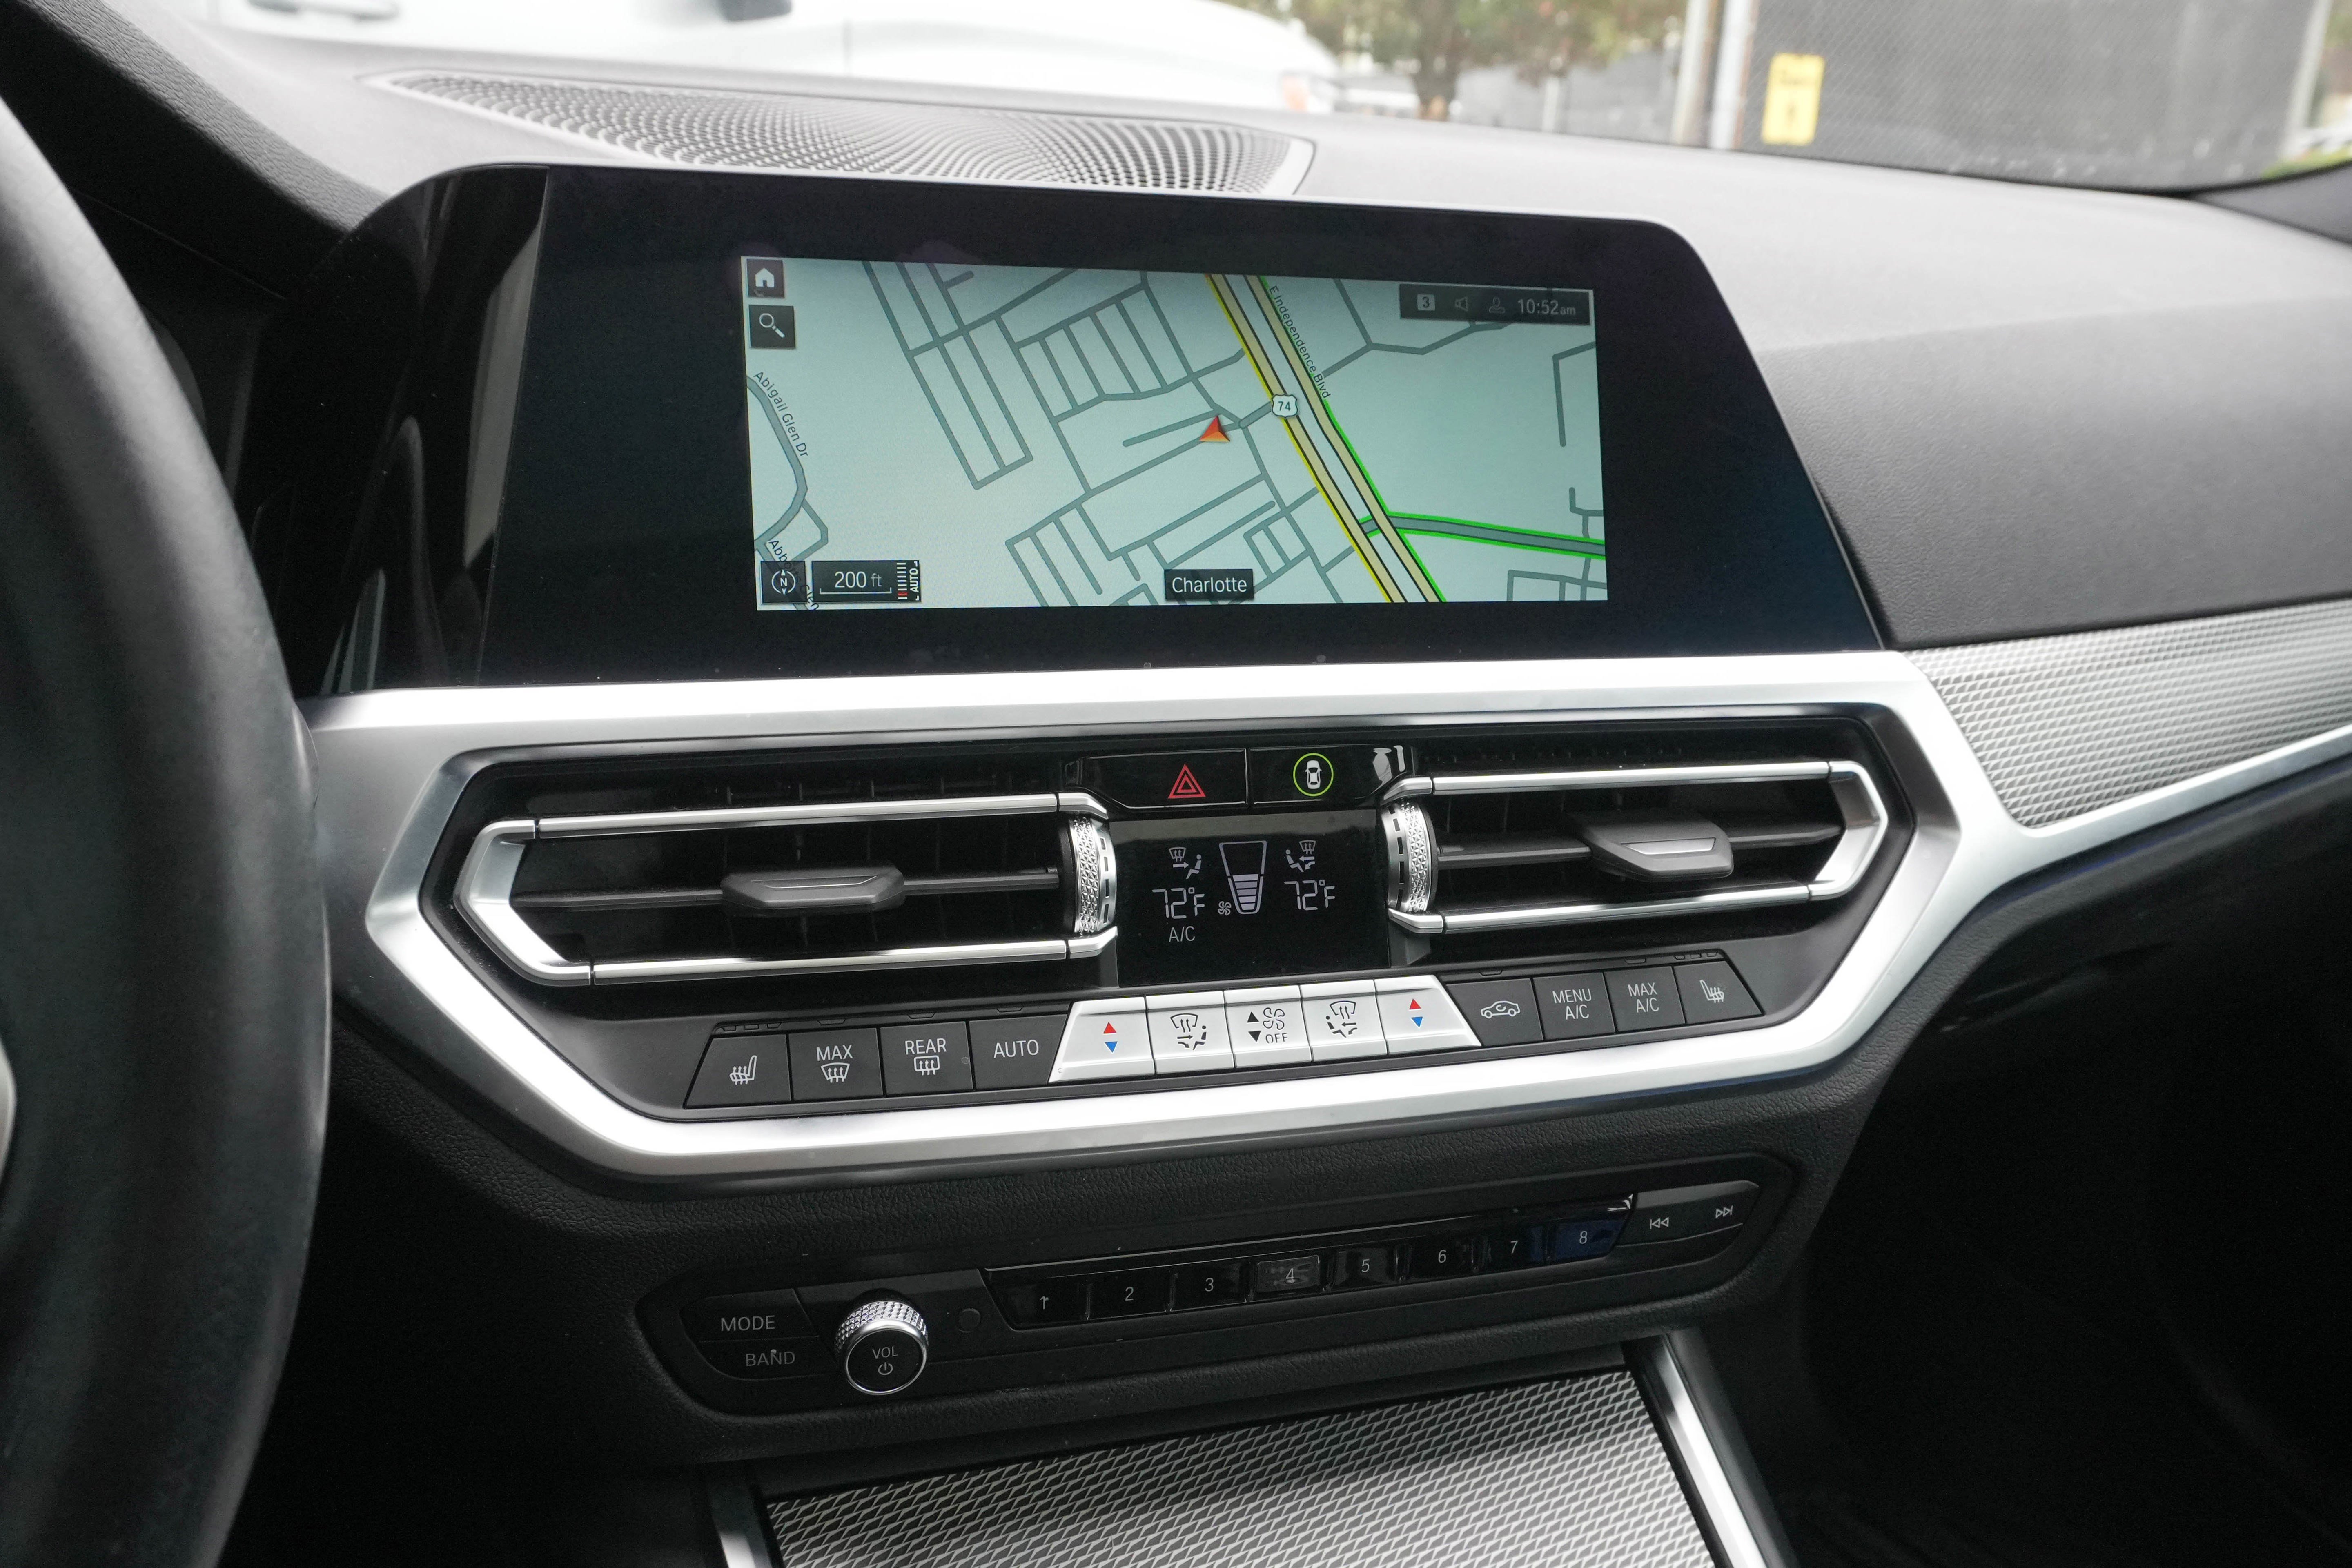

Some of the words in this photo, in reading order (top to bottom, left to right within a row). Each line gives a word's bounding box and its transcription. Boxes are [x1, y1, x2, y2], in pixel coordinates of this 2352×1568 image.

[1269, 285, 1279, 295] E
[1422, 296, 1430, 308] 3
[1273, 295, 1316, 372] Independence
[1313, 373, 1331, 399] Blvd
[1278, 401, 1291, 411] 74
[753, 372, 788, 412] Abigail
[782, 413, 800, 441] Glen
[796, 442, 808, 457] Dr
[780, 577, 788, 587] N
[834, 571, 867, 588] 200
[870, 572, 882, 587] ft
[909, 568, 919, 592] AUTO
[1172, 577, 1247, 593] Charlotte
[1168, 925, 1196, 943] A/C
[1552, 988, 1592, 1004] MENU
[1627, 982, 1658, 997] MAX
[1565, 1004, 1590, 1020] A/C
[1636, 997, 1659, 1013] A/C
[1265, 1032, 1288, 1044] OFF
[816, 1044, 853, 1062] MAX
[904, 1038, 947, 1055] REAR
[993, 1039, 1039, 1059] AUTO
[1579, 1230, 1588, 1245] 8
[1510, 1240, 1519, 1254] 7
[1438, 1249, 1447, 1263] 6
[1361, 1258, 1370, 1273] 5
[1285, 1267, 1296, 1281] 4
[1205, 1277, 1214, 1292] 3
[1125, 1286, 1134, 1301] 2
[721, 1315, 775, 1332] MODE
[745, 1350, 795, 1367] BAND
[872, 1346, 898, 1359] VOL
